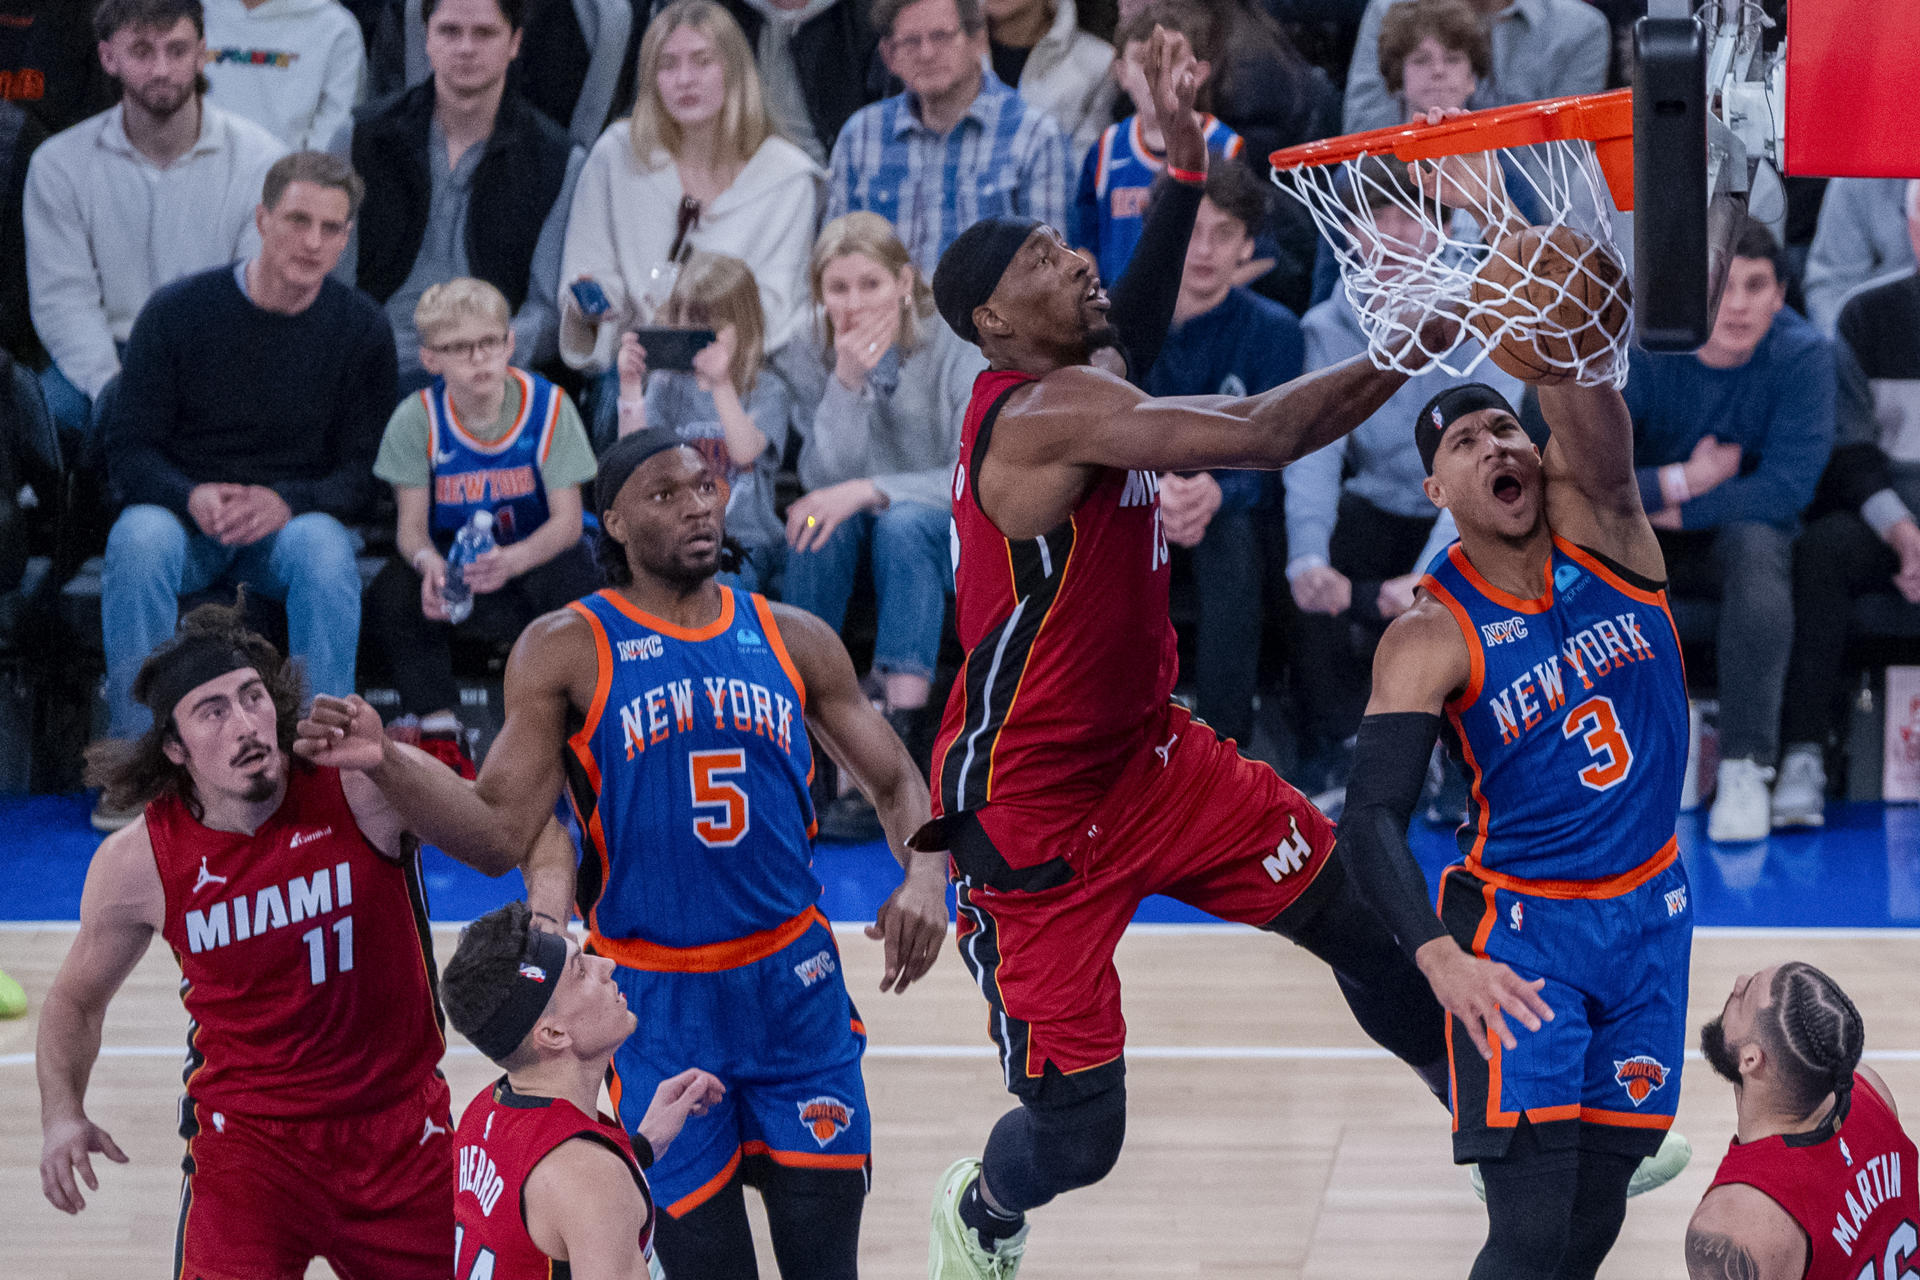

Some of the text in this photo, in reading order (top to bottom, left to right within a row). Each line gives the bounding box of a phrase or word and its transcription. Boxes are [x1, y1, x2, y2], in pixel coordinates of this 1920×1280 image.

[617, 634, 664, 662] NYC
[1481, 616, 1528, 647] NYC
[620, 677, 792, 760] NEW YORK
[1490, 613, 1655, 744] NEW YORK
[1561, 695, 1634, 791] 3
[688, 747, 750, 848] 5
[186, 861, 353, 954] MIAMI
[302, 915, 353, 985] 11
[1617, 1061, 1664, 1084] KNICKS
[459, 1145, 504, 1218] HERRO
[1832, 1152, 1901, 1257] MARTIN
